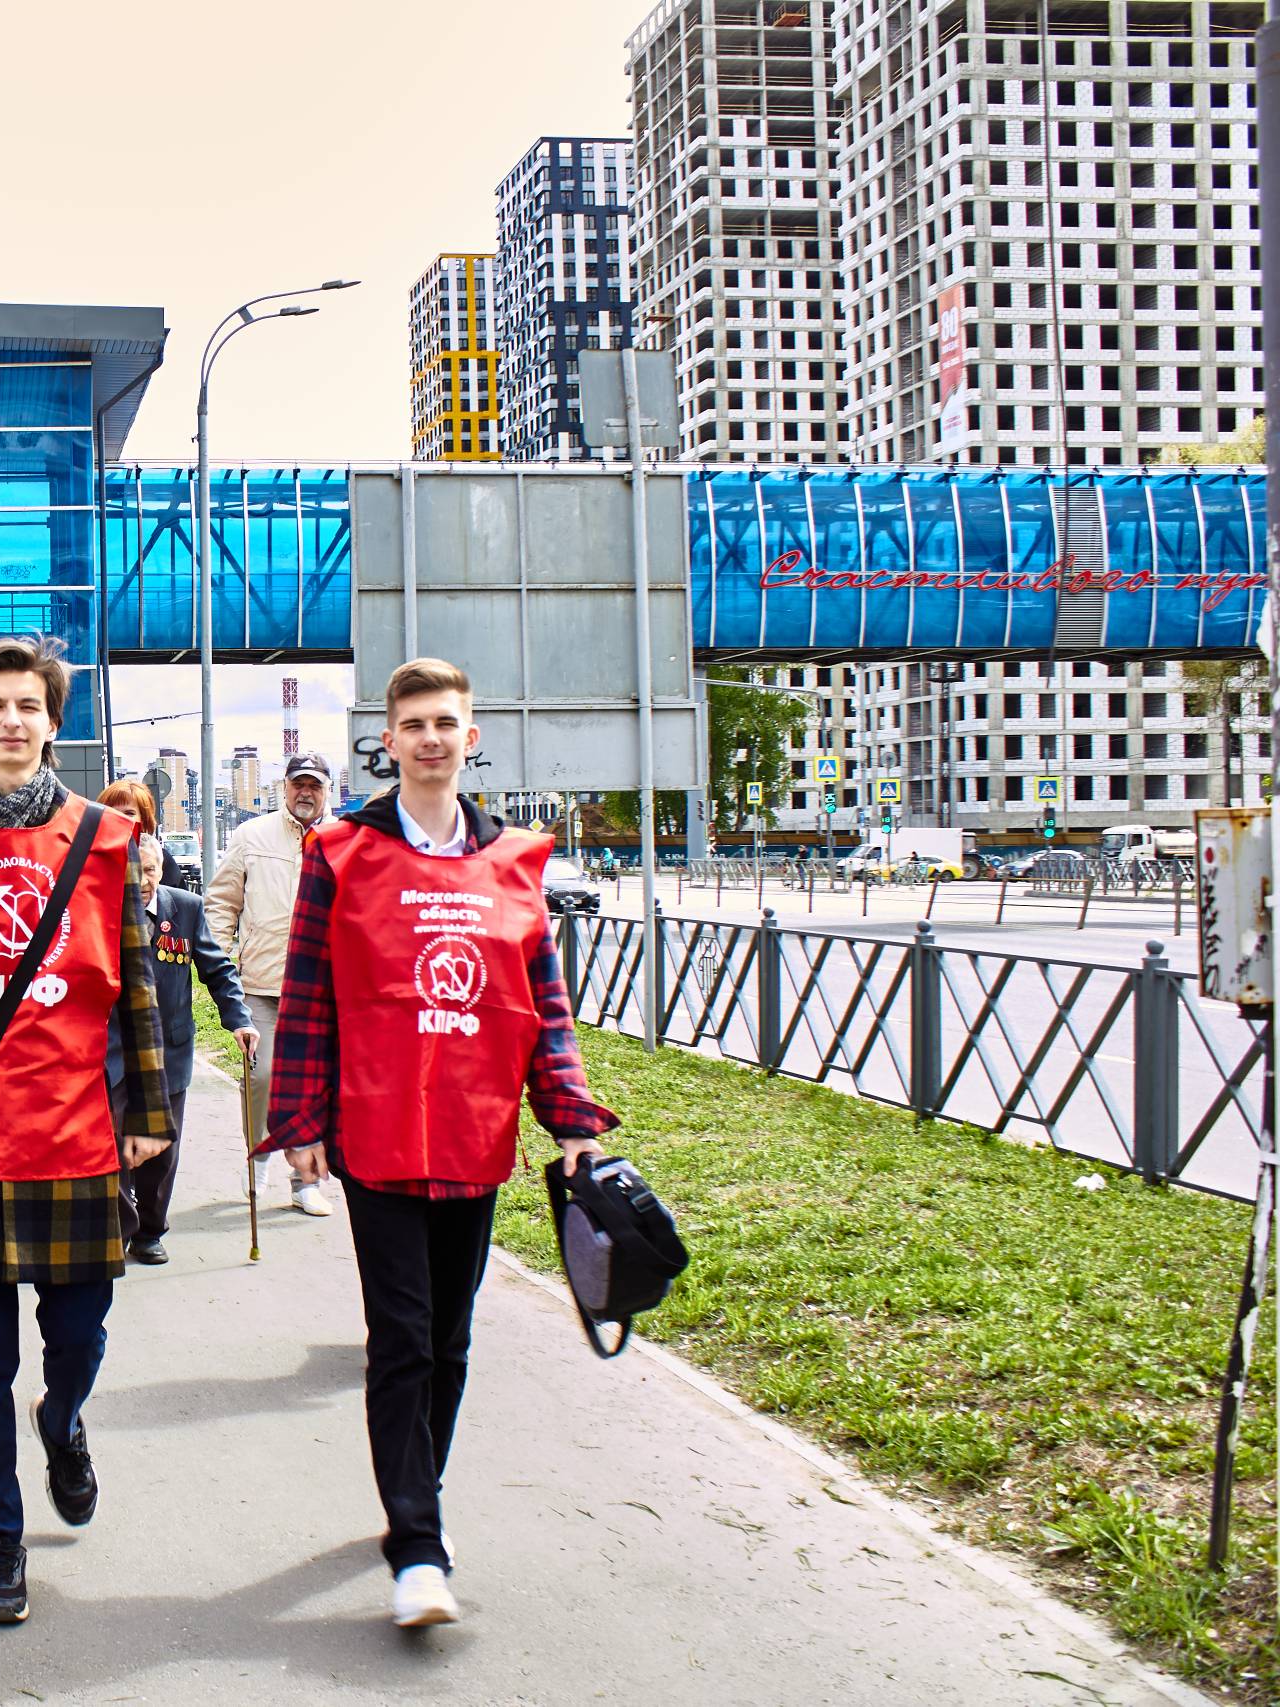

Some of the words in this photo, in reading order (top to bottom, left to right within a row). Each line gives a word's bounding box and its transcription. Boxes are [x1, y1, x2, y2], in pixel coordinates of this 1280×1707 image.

[760, 550, 1161, 593] Счастливого
[1175, 568, 1270, 612] пут
[400, 889, 494, 908] Московская
[419, 905, 481, 921] область
[42, 908, 70, 967] ОЦИАЛИЗМ
[418, 1009, 480, 1037] КПРФ
